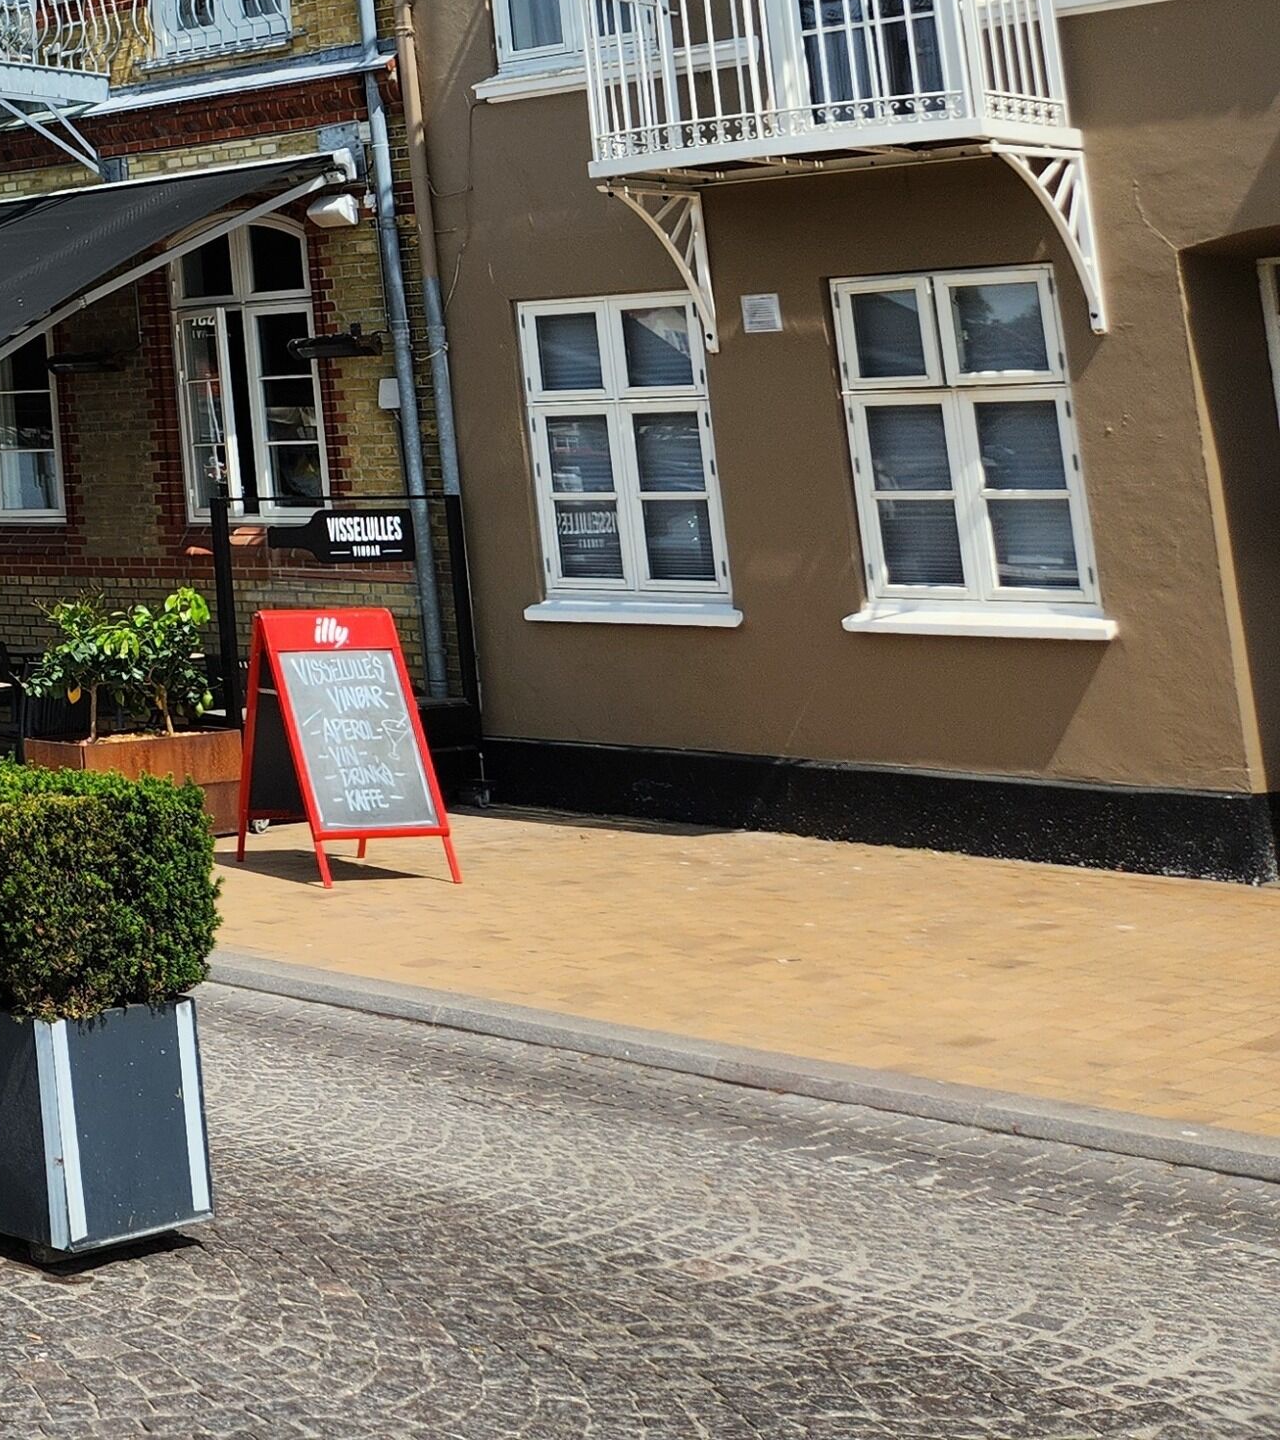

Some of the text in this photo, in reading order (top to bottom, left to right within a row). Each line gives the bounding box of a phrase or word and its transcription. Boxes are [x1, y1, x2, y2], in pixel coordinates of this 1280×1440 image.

[326, 516, 403, 542] VISSELULLES
[352, 545, 381, 557] VINBAR
[315, 617, 350, 648] illy
[327, 685, 389, 714] VINBAR
[323, 717, 382, 744] APEROL
[329, 746, 359, 767] VIN
[345, 789, 389, 811] KAFFE
